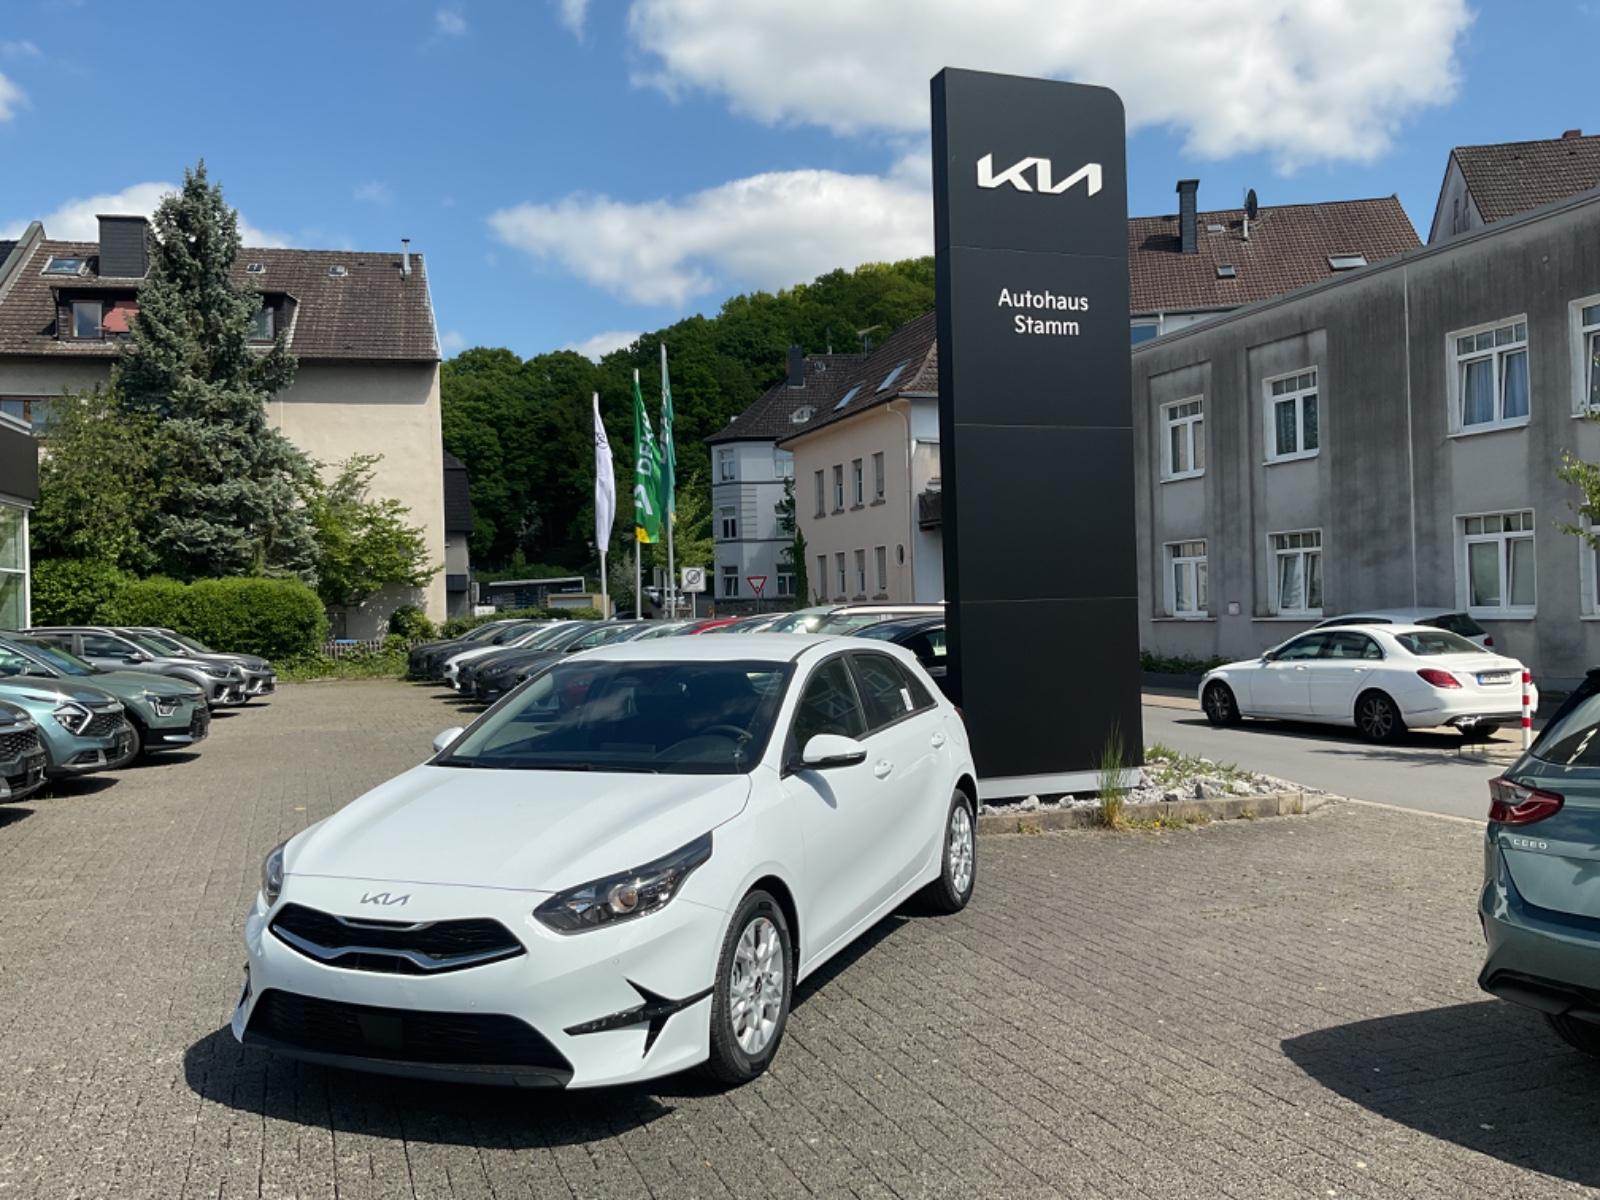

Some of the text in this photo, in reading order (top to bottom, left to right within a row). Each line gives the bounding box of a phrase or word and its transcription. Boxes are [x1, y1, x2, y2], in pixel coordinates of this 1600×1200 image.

[977, 152, 1103, 198] KIA
[998, 287, 1089, 312] Autohaus
[1014, 314, 1080, 336] Stamm
[360, 891, 411, 906] KIA
